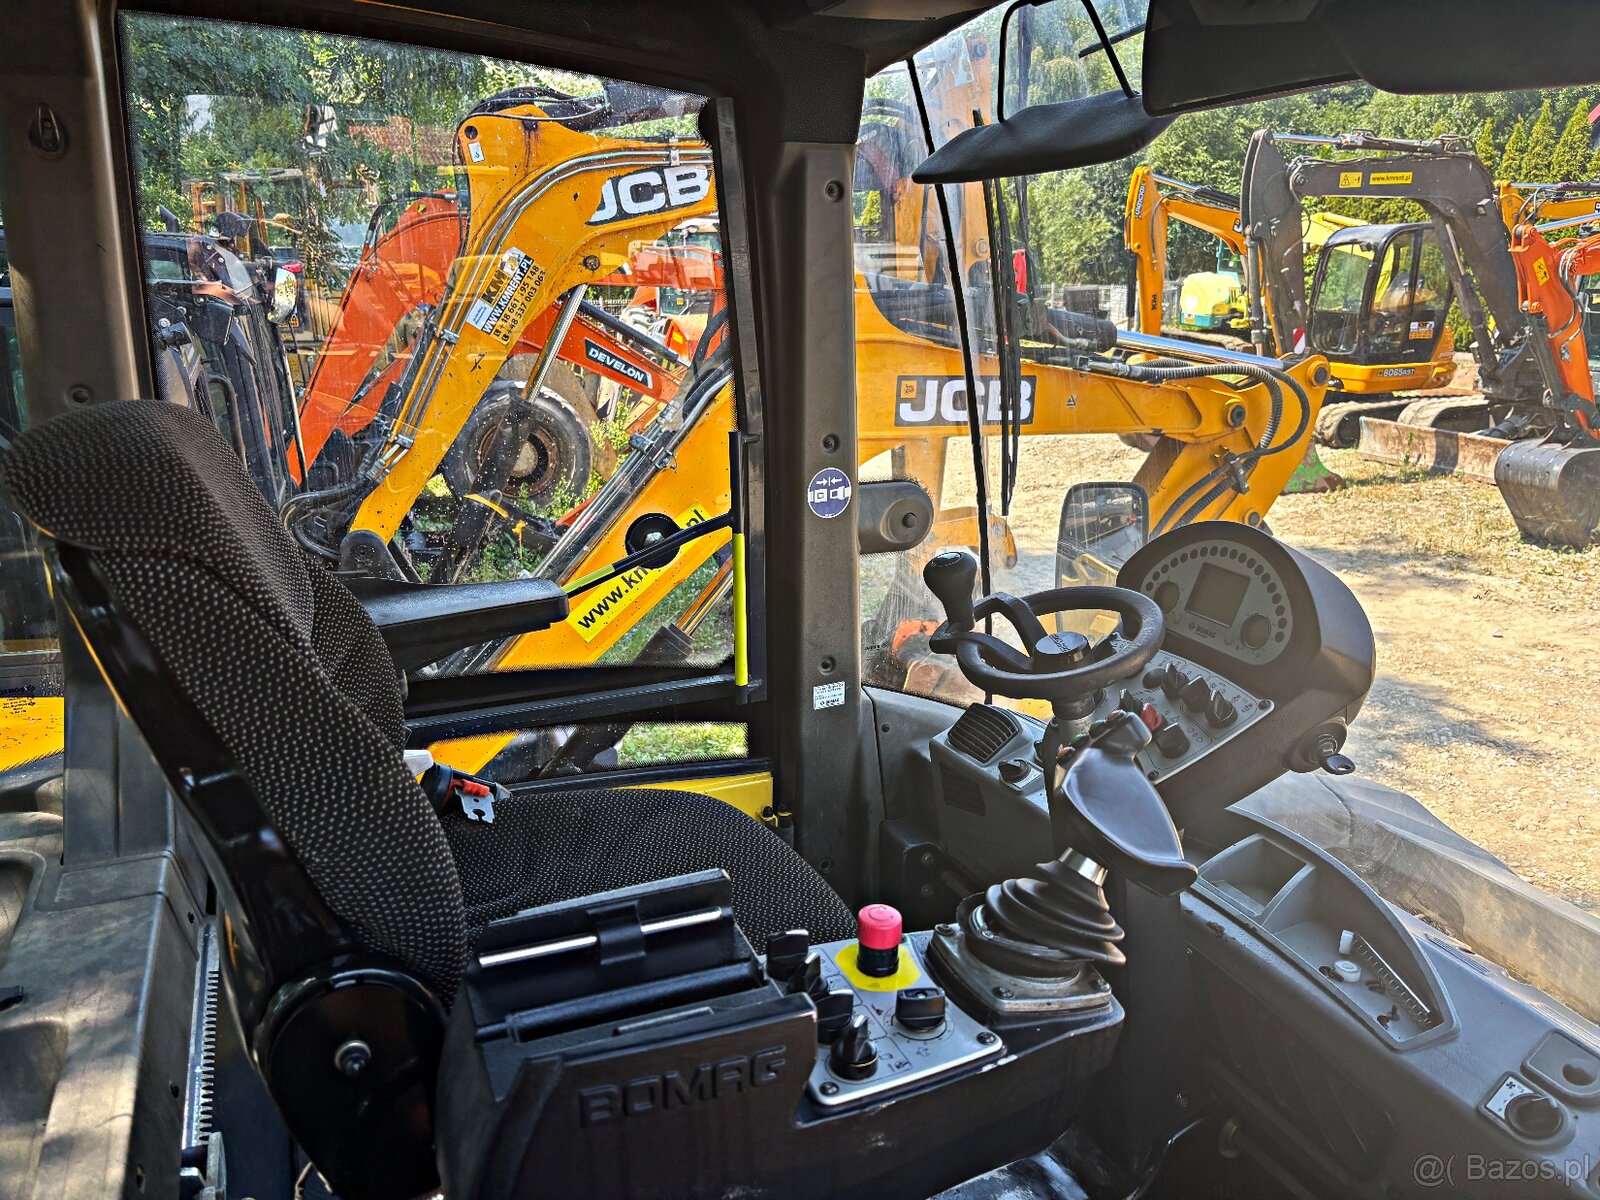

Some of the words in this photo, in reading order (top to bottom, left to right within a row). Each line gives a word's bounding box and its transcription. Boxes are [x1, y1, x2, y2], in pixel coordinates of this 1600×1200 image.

[590, 164, 711, 222] JCB
[481, 269, 508, 304] KM
[482, 258, 533, 334] WWW.KMRENT.PL
[588, 347, 645, 382] DEVELON
[899, 379, 1032, 422] JCB
[578, 1045, 786, 1128] BOMAG
